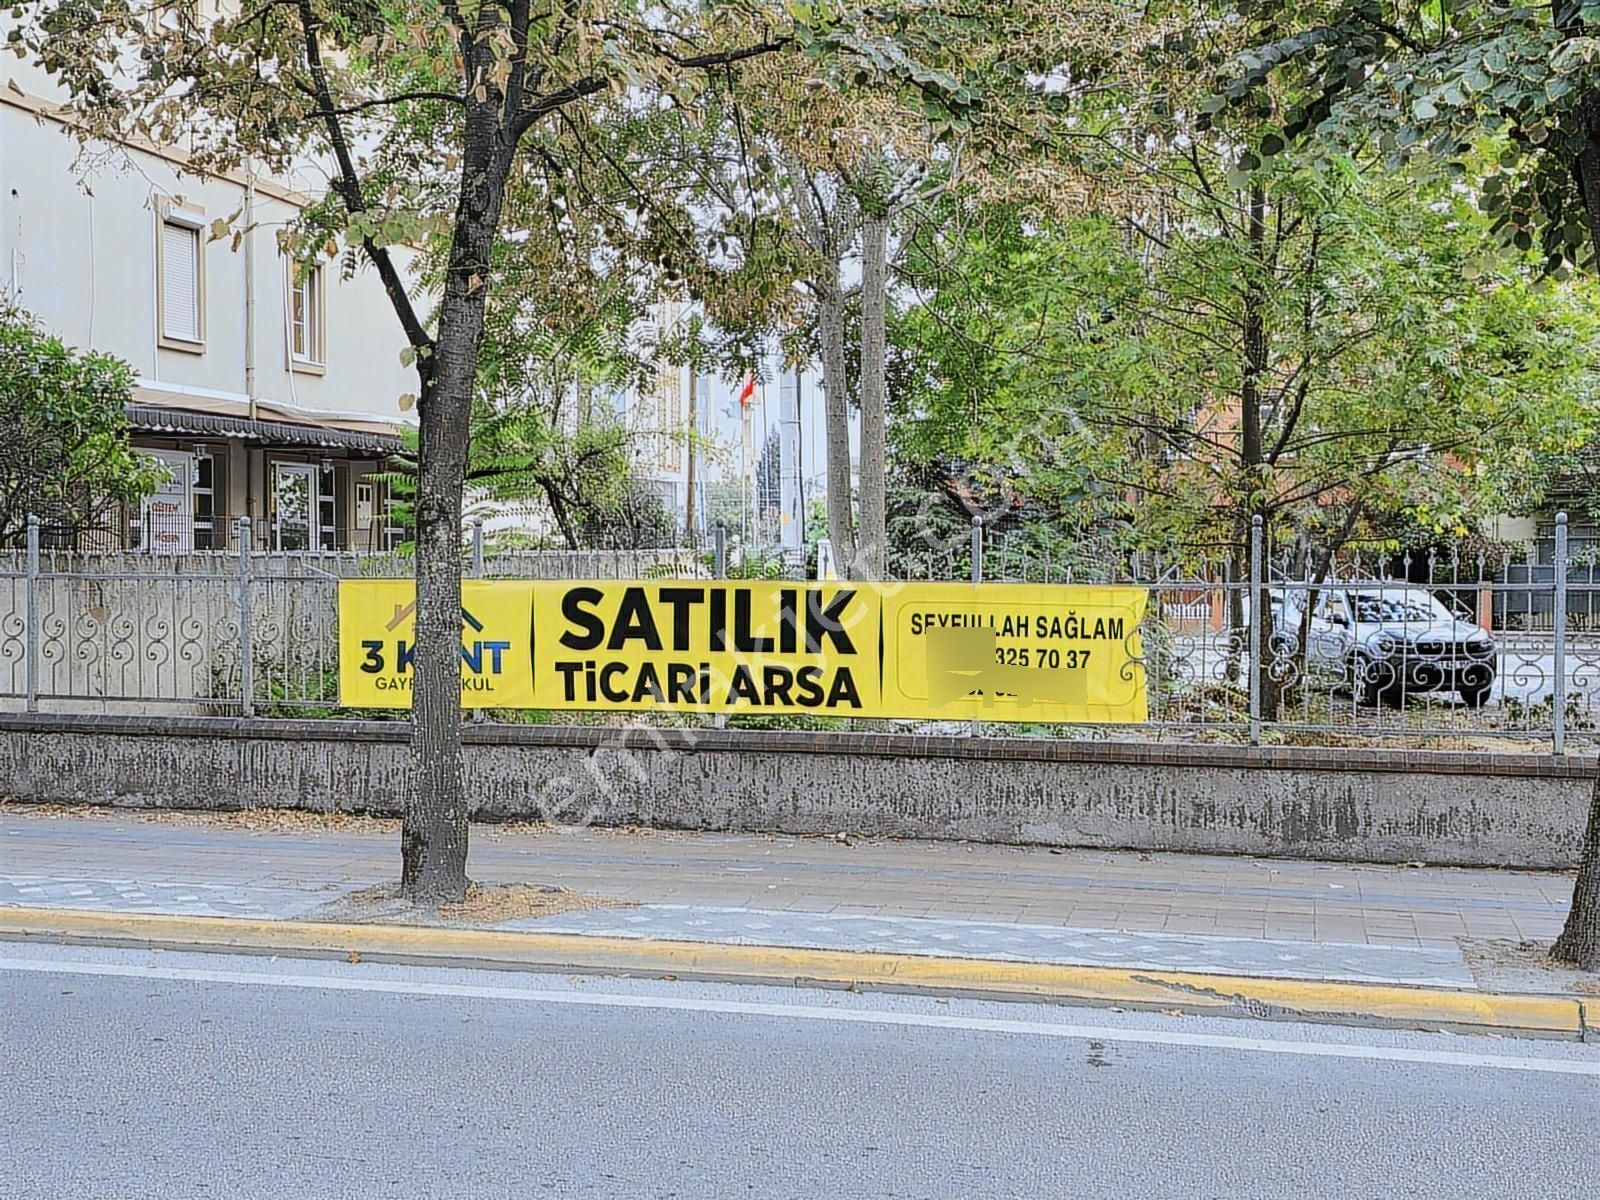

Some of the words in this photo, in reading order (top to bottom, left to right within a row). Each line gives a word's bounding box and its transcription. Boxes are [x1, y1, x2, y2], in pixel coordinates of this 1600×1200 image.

[559, 587, 858, 654] SATILIK
[1036, 611, 1124, 640] SAĞLAM
[360, 640, 385, 673] 3
[397, 640, 511, 674] KNT
[996, 647, 1029, 666] 325
[1036, 649, 1060, 668] 70
[1067, 650, 1091, 668] 37
[375, 677, 494, 691] GAYKUL
[725, 664, 863, 708] ARSA
